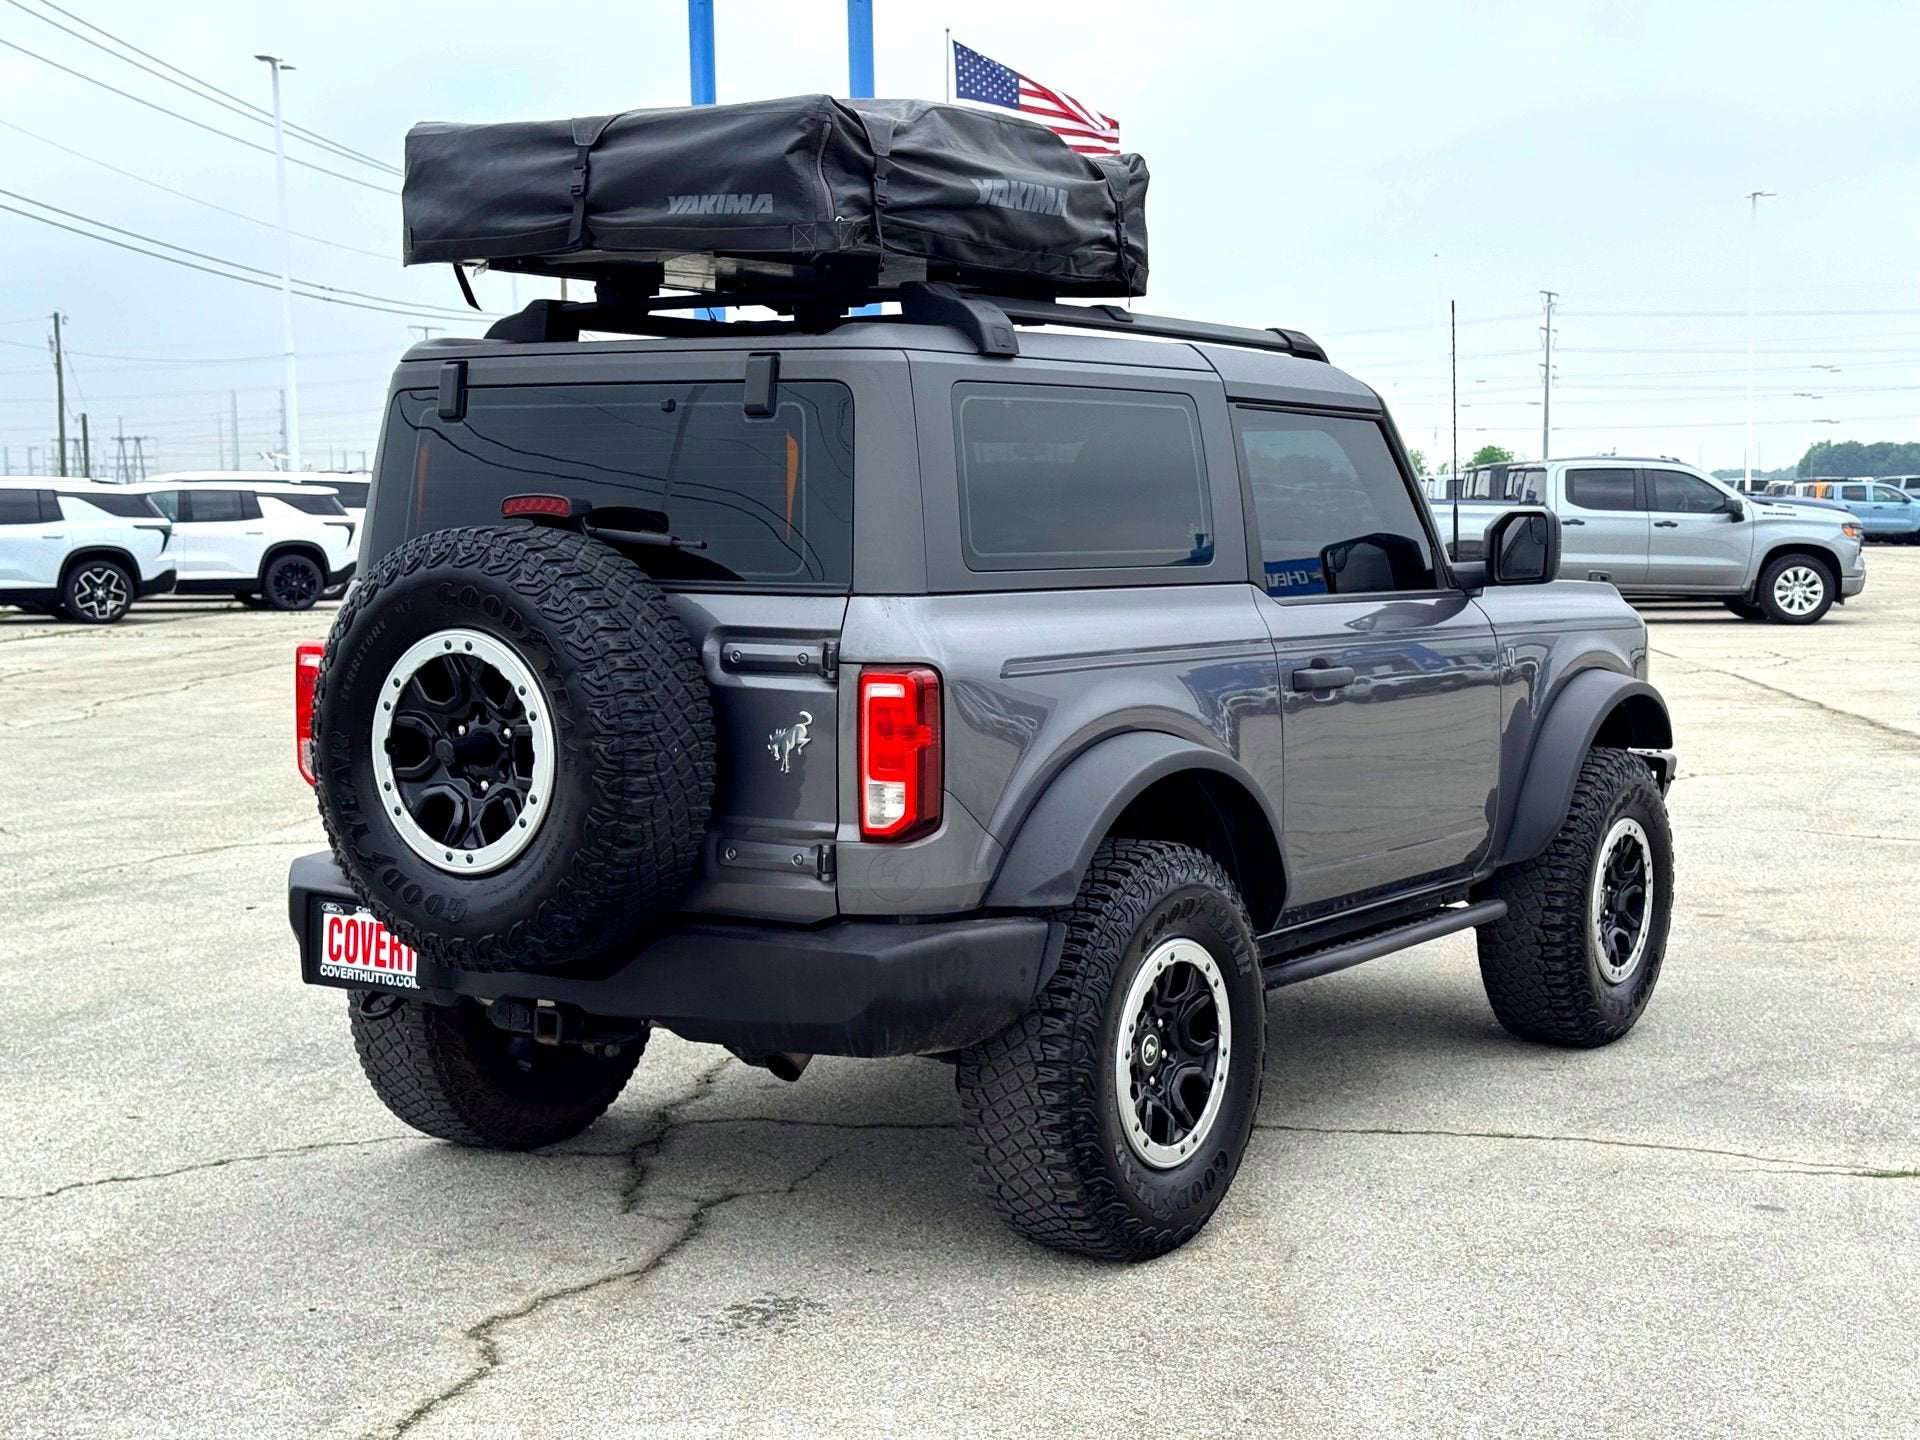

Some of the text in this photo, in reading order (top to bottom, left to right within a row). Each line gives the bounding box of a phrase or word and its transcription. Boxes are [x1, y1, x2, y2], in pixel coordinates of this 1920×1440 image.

[667, 193, 773, 214] YAKIMA
[340, 616, 387, 702] TERRITORY
[331, 732, 469, 923] GOODYEAR
[1141, 892, 1251, 978] GOODYEAR
